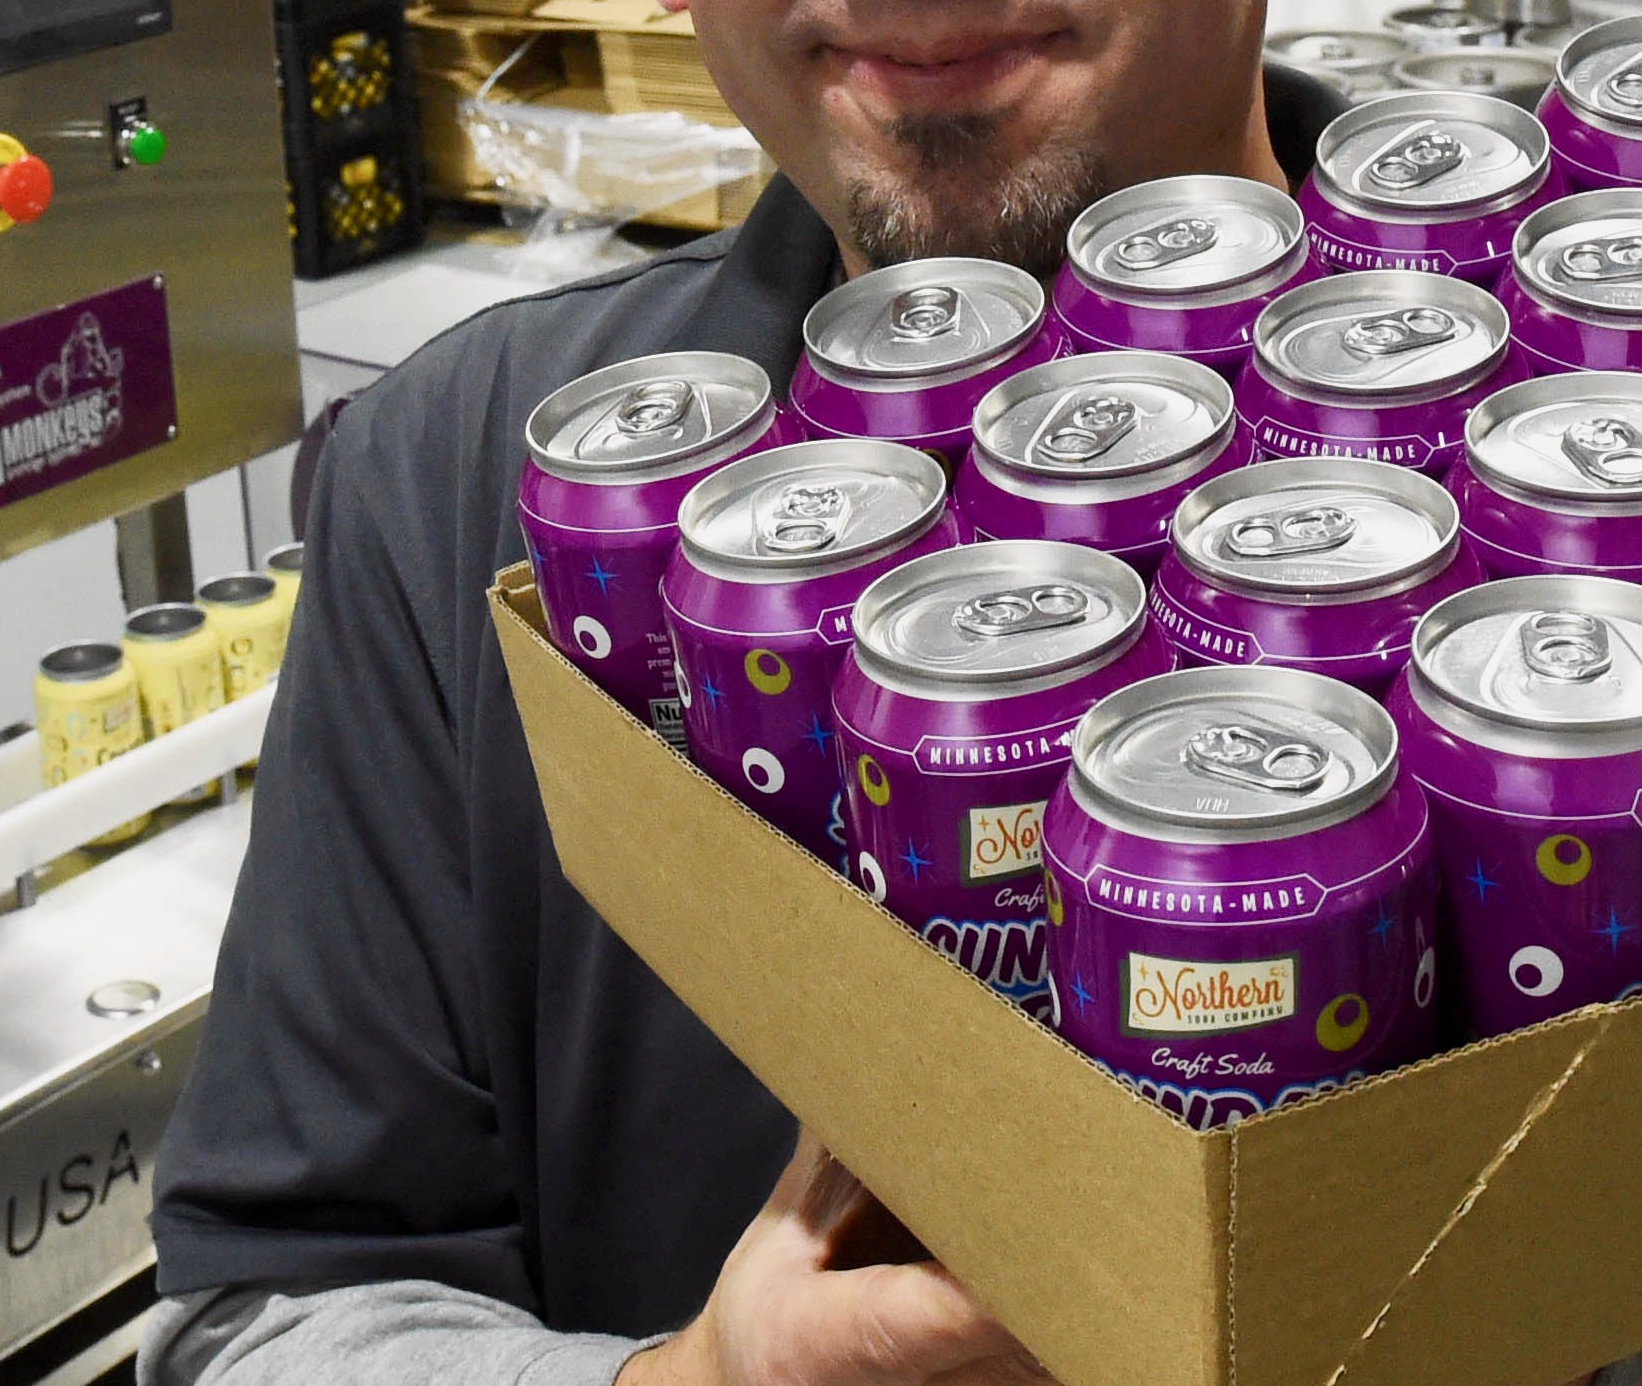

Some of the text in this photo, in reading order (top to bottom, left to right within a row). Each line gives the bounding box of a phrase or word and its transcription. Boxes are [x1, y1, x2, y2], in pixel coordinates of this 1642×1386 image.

[1099, 878, 1306, 914] MINNESOTA-MADE
[1135, 967, 1284, 1021] Northern
[1151, 1047, 1275, 1080] Craft Soda
[4, 1128, 142, 1258] USA
